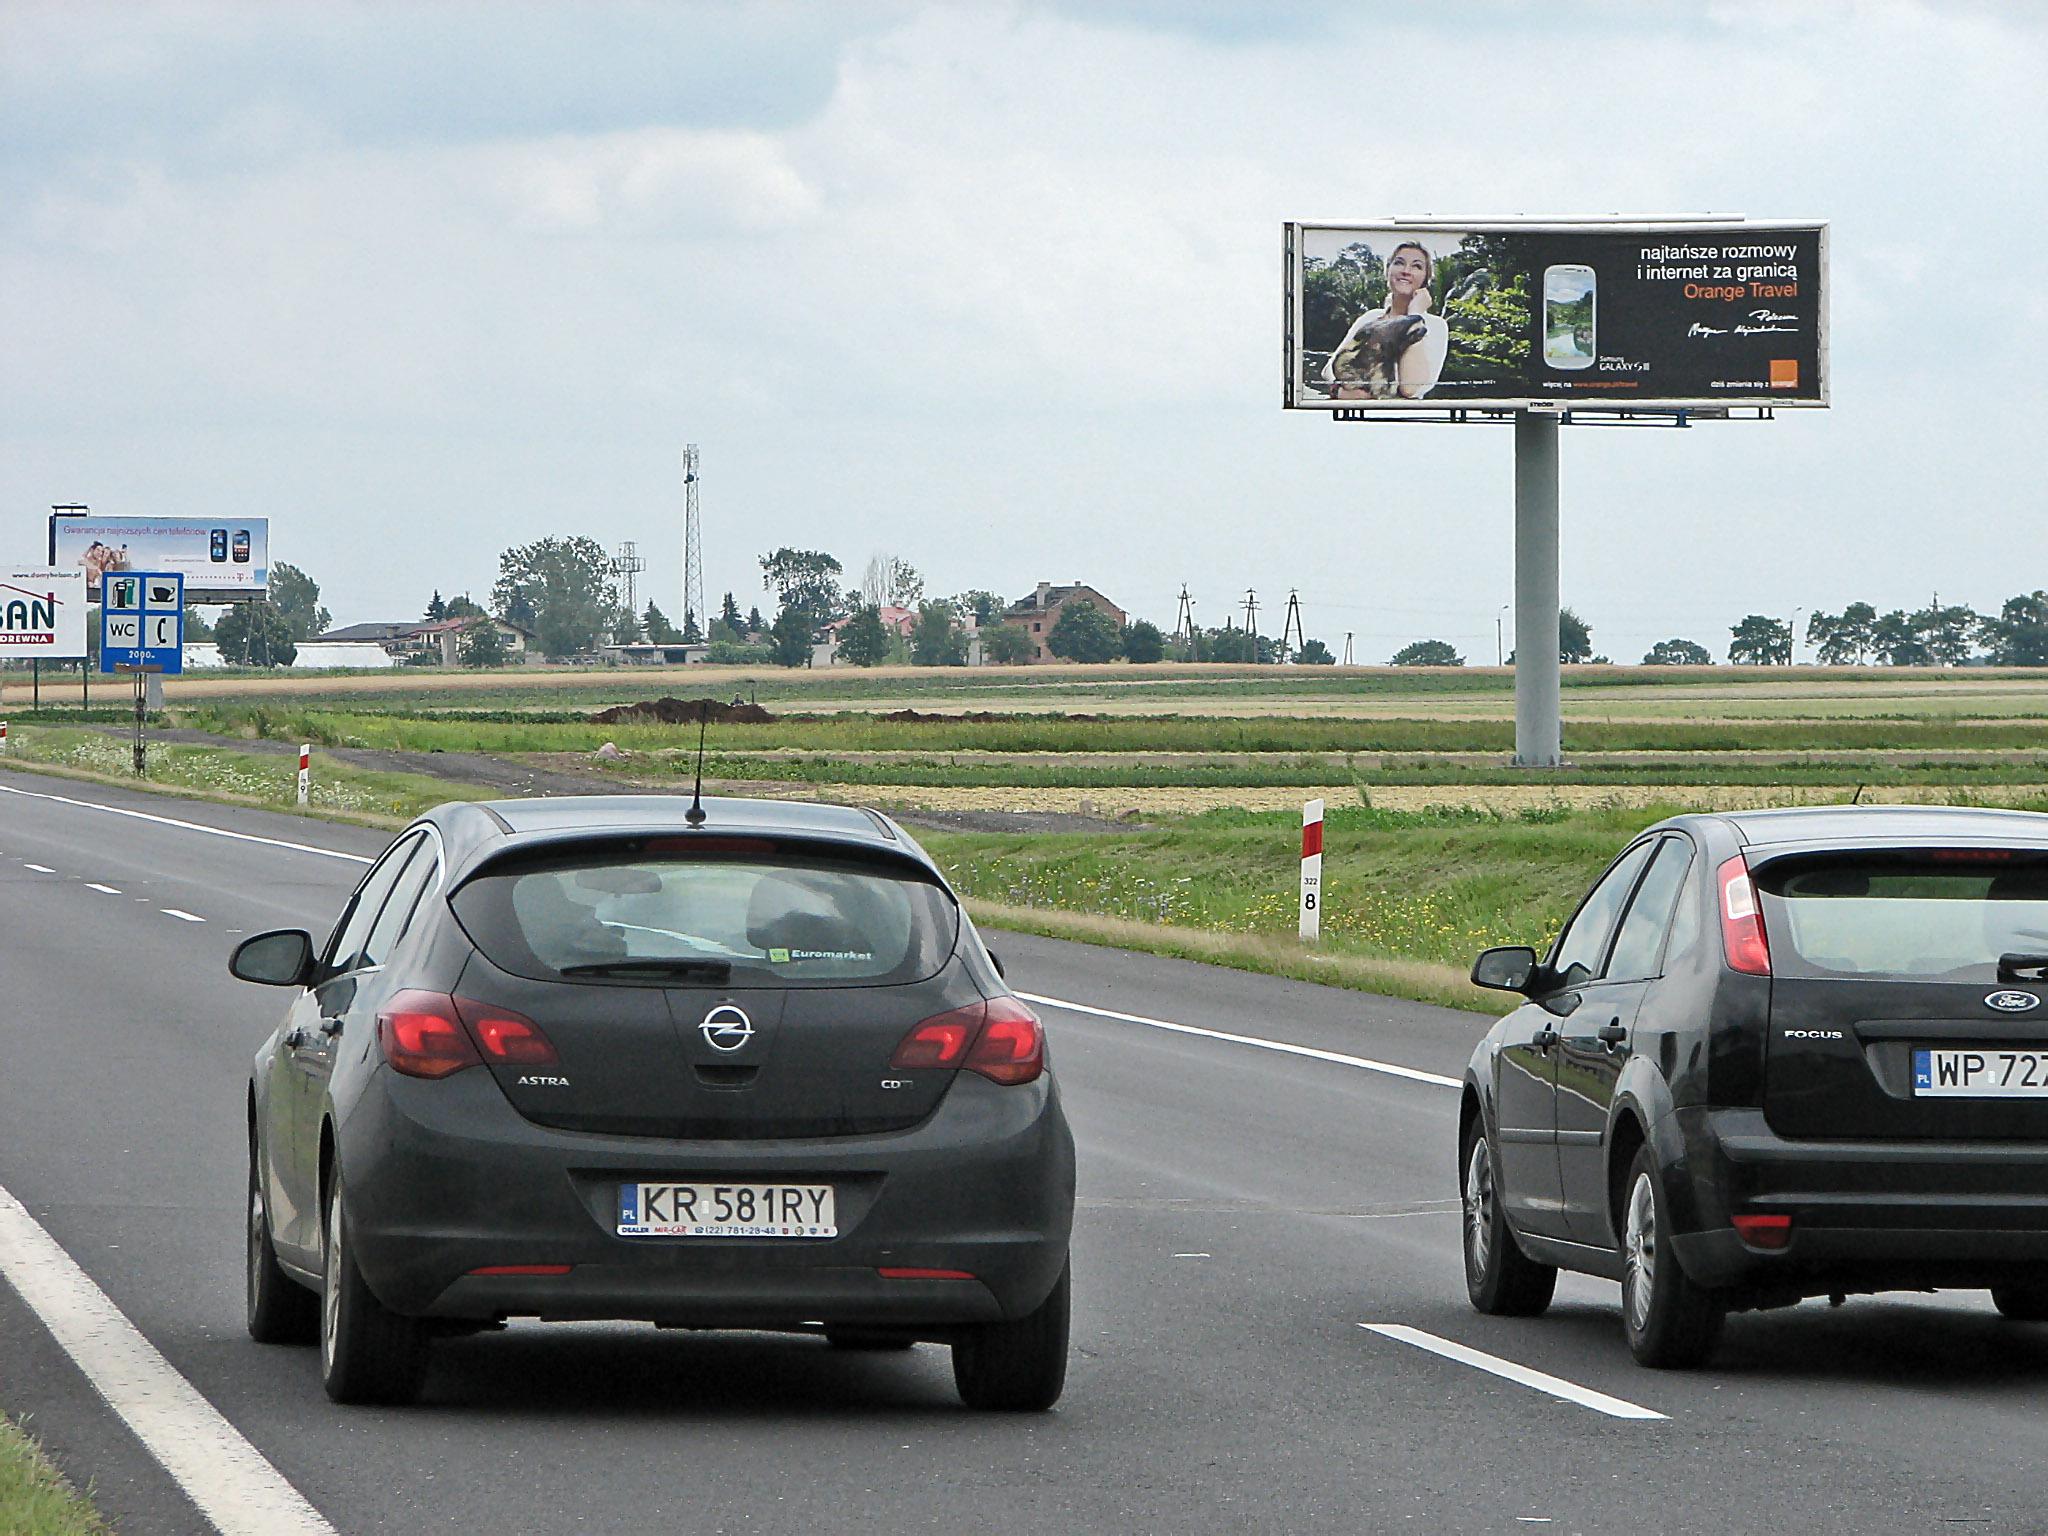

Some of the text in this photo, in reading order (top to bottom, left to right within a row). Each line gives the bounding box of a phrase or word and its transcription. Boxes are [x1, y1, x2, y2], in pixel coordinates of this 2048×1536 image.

[1640, 244, 1797, 263] najtańsze rozmowy
[1637, 262, 1798, 281] i internet za granicą
[1684, 282, 1798, 301] Orange Travel
[1599, 362, 1634, 371] GALAXY
[0, 599, 54, 629] AN
[110, 623, 135, 637] WC
[1304, 877, 1318, 885] 322
[1305, 893, 1316, 910] 8
[791, 949, 872, 960] Euromarket
[1998, 993, 2028, 1007] Ford
[1784, 1030, 1843, 1039] FOCUS
[1937, 1054, 1985, 1087] WP
[518, 1076, 569, 1086] ASTRA
[1917, 1074, 1930, 1084] PL
[643, 1187, 827, 1223] KR 581RY
[622, 1209, 636, 1220] PL
[654, 1225, 687, 1234] MIR-CAR
[705, 1226, 723, 1235] (22)
